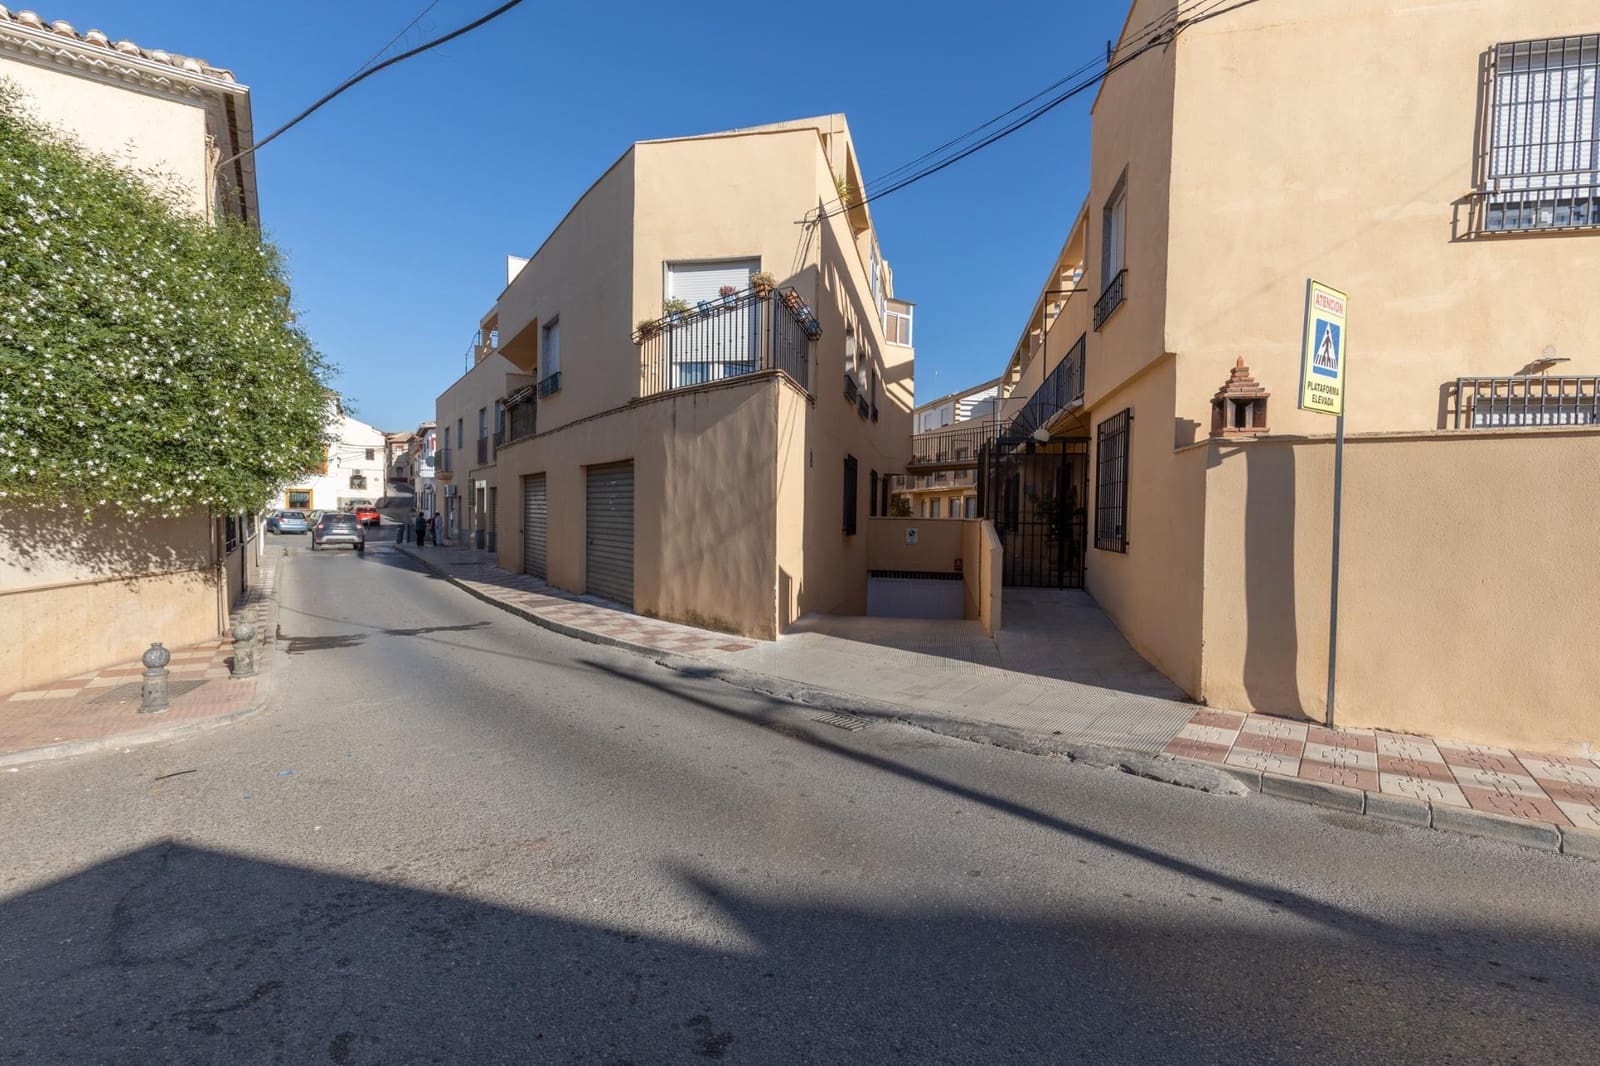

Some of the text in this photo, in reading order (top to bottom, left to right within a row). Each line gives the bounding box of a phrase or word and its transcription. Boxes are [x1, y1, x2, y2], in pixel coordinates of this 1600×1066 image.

[1315, 293, 1343, 313] ATENCION
[1307, 381, 1339, 396] PLATAFORMA
[1312, 394, 1334, 407] ELEVADA
